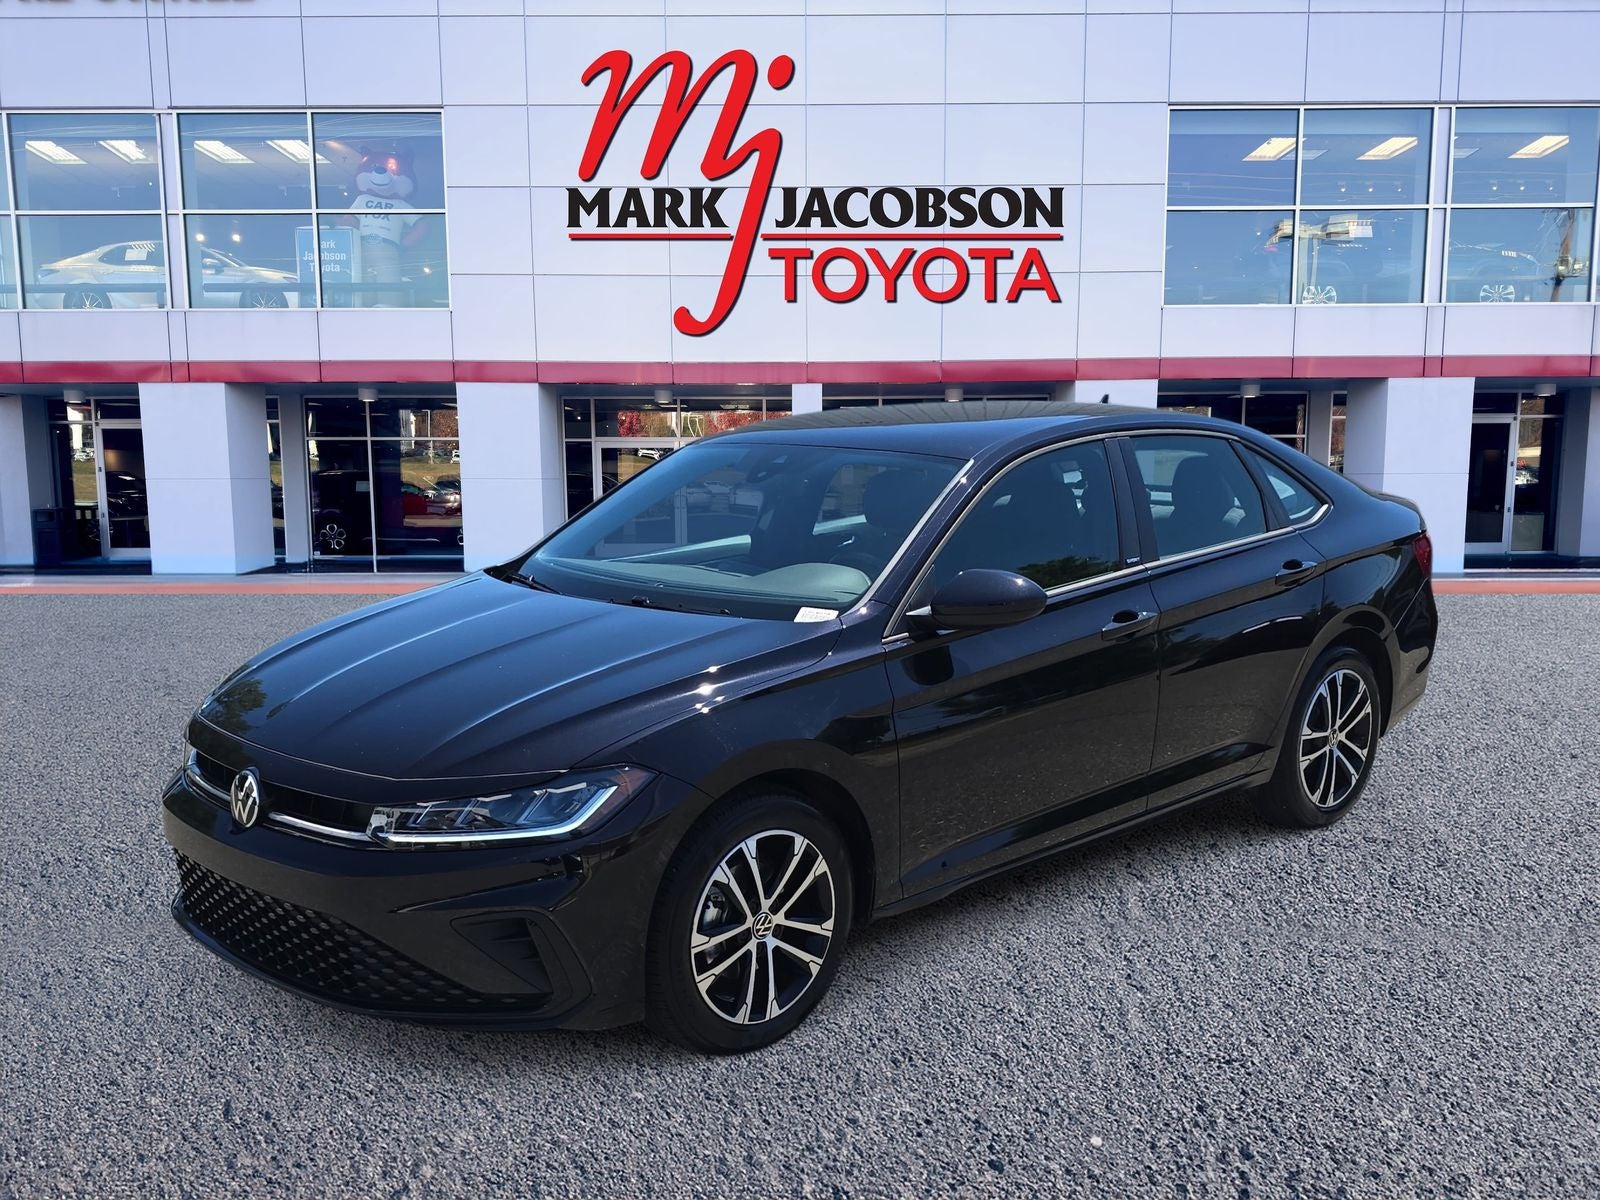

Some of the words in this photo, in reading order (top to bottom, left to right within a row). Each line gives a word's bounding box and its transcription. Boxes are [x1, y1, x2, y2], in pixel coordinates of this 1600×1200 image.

[565, 187, 729, 229] MARK
[775, 187, 1064, 229] JACOBSON
[313, 240, 336, 249] ark
[309, 262, 340, 272] Tyota
[767, 247, 1063, 304] TOYOTA
